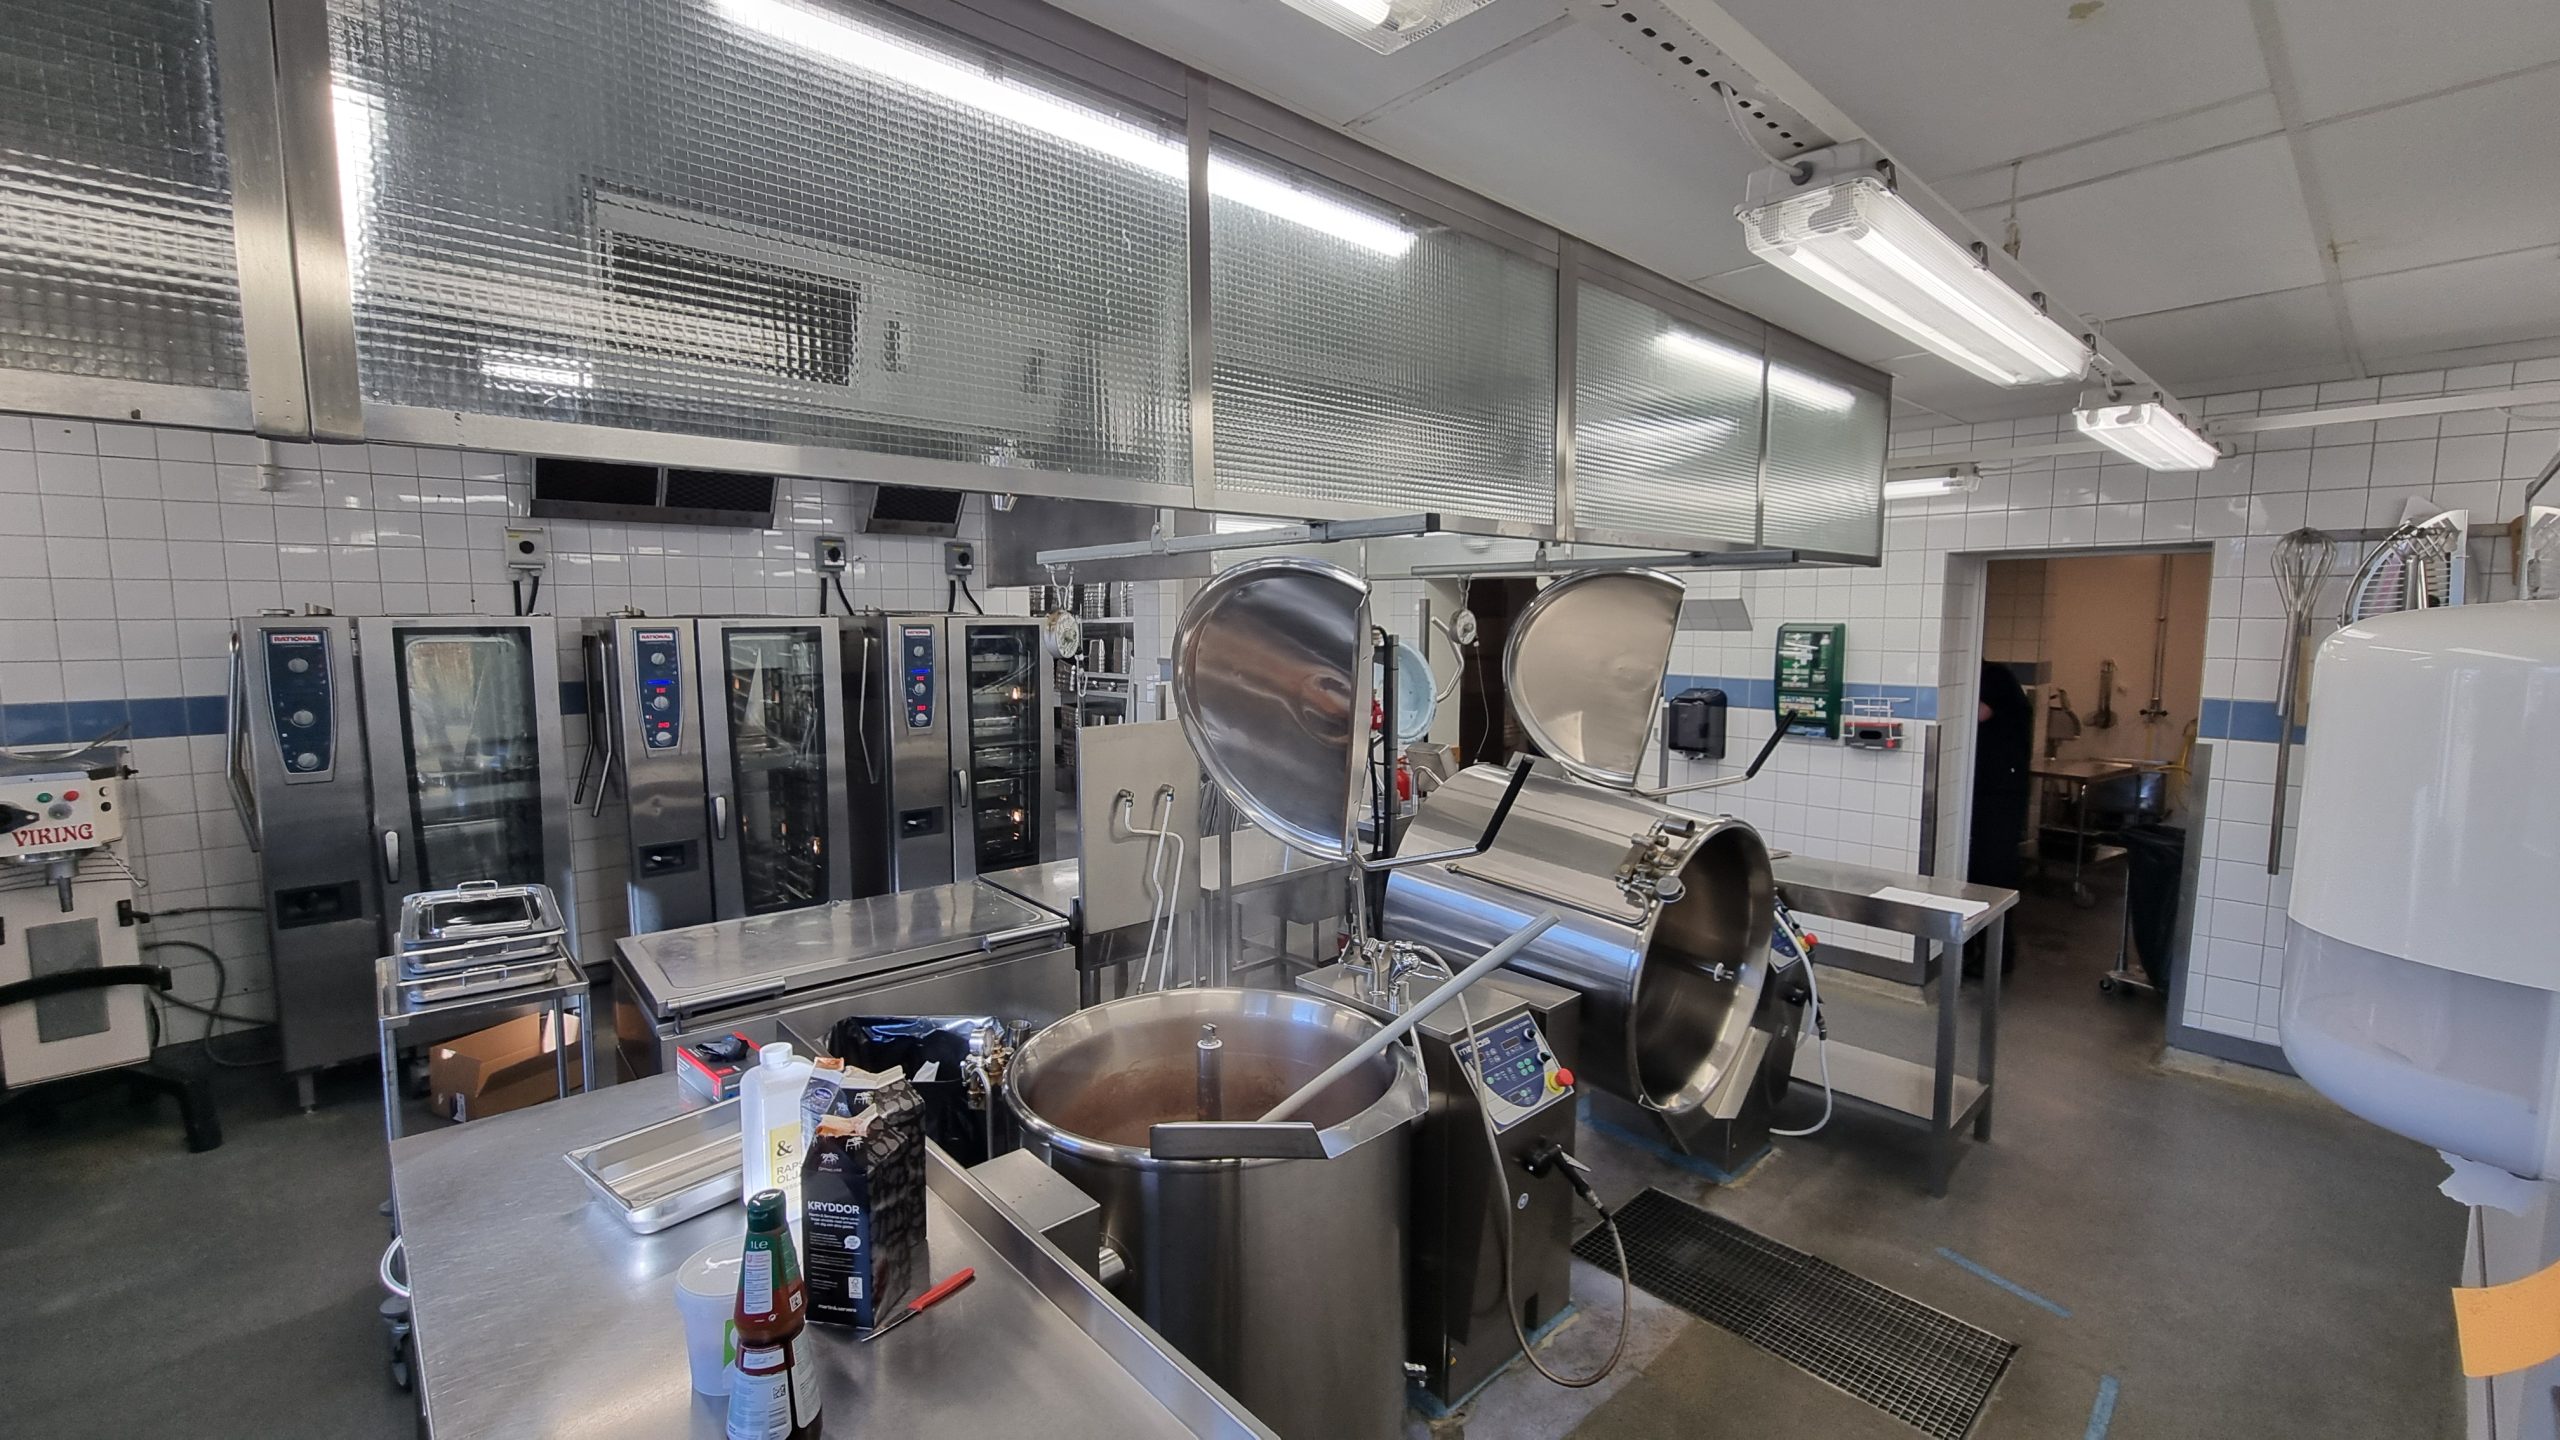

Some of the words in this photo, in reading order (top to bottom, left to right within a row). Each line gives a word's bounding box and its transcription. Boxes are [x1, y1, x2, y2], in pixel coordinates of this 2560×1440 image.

[12, 823, 94, 847] VIKING
[776, 1140, 793, 1157] &
[777, 1170, 802, 1184] OLJ
[807, 1200, 860, 1215] KRYDDOR
